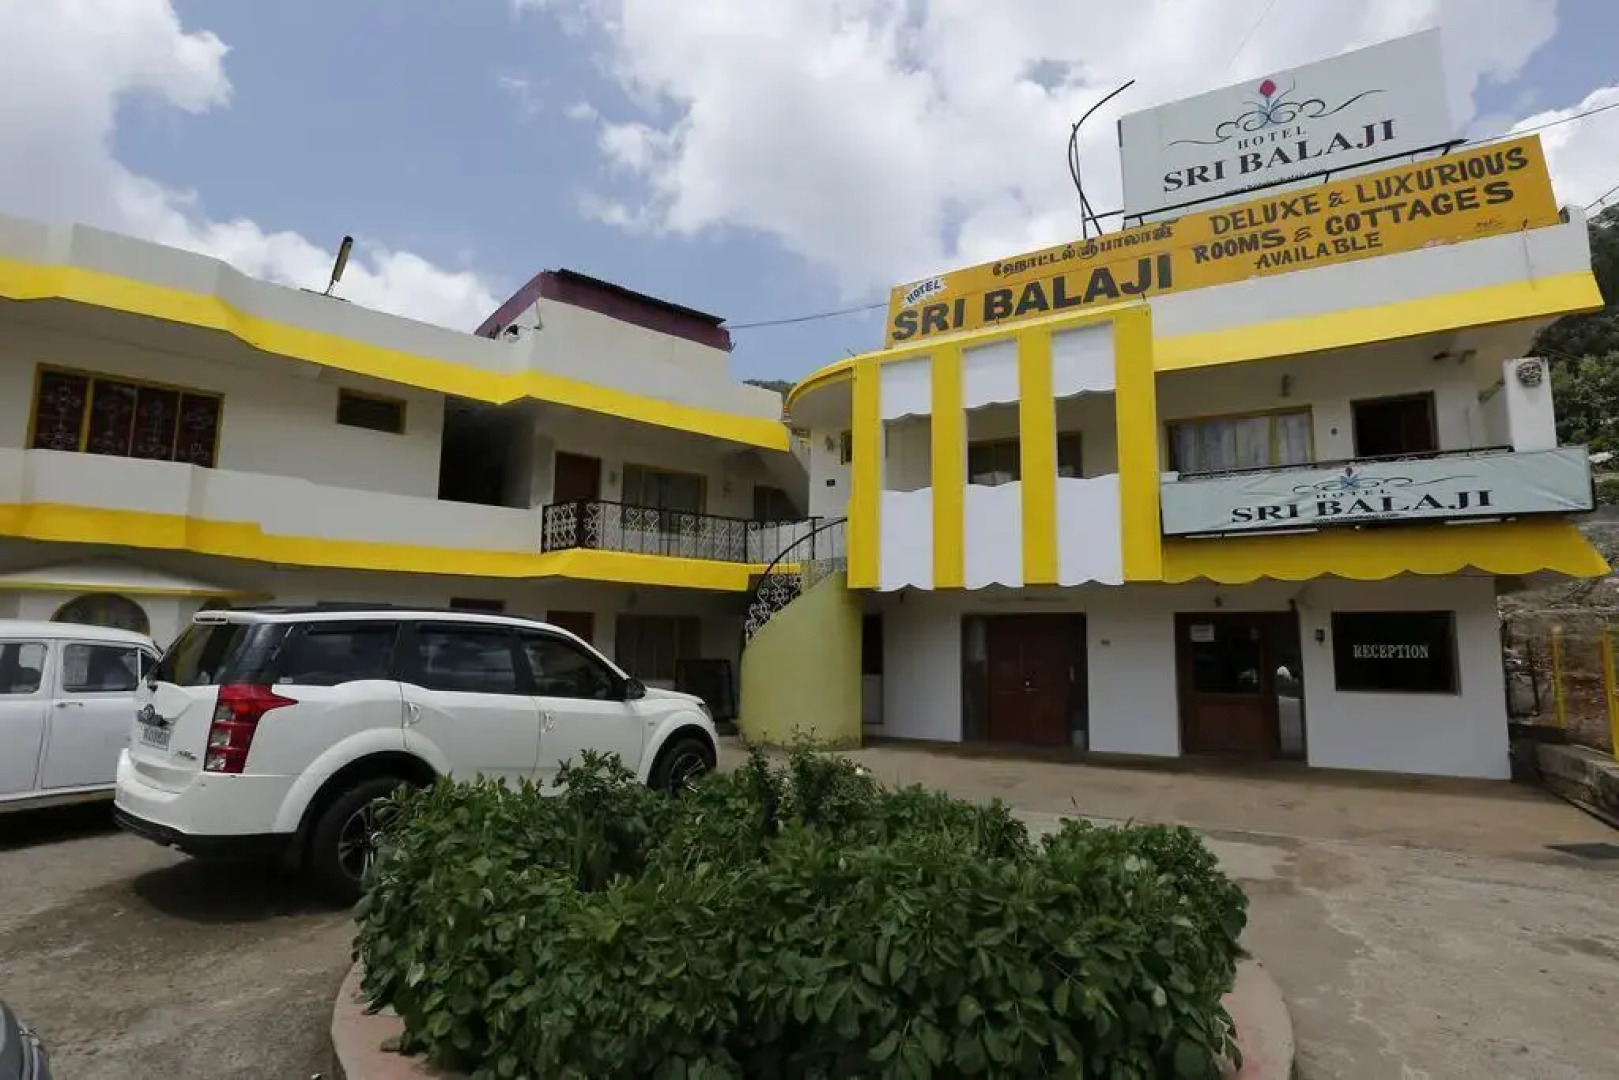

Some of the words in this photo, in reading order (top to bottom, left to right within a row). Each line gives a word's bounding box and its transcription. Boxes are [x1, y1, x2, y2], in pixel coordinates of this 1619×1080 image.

[1238, 125, 1307, 150] HOTEL
[1163, 160, 1228, 192] SRI
[1240, 119, 1397, 175] BALAJI
[1209, 192, 1323, 236] DELUXE
[1328, 190, 1351, 208] &
[1355, 147, 1529, 203] LUXURIOUS
[1193, 228, 1286, 265] ROOMS
[1324, 181, 1515, 237] COTTAGES
[1254, 232, 1383, 269] AVAILABLE
[892, 298, 966, 341] SRI
[983, 254, 1173, 322] BALAJI
[906, 279, 942, 303] HOTEL
[1231, 503, 1300, 523] SRI
[1317, 489, 1493, 516] BALAJI
[1316, 488, 1392, 499] HOTEL
[1353, 644, 1429, 659] RECEPTION
